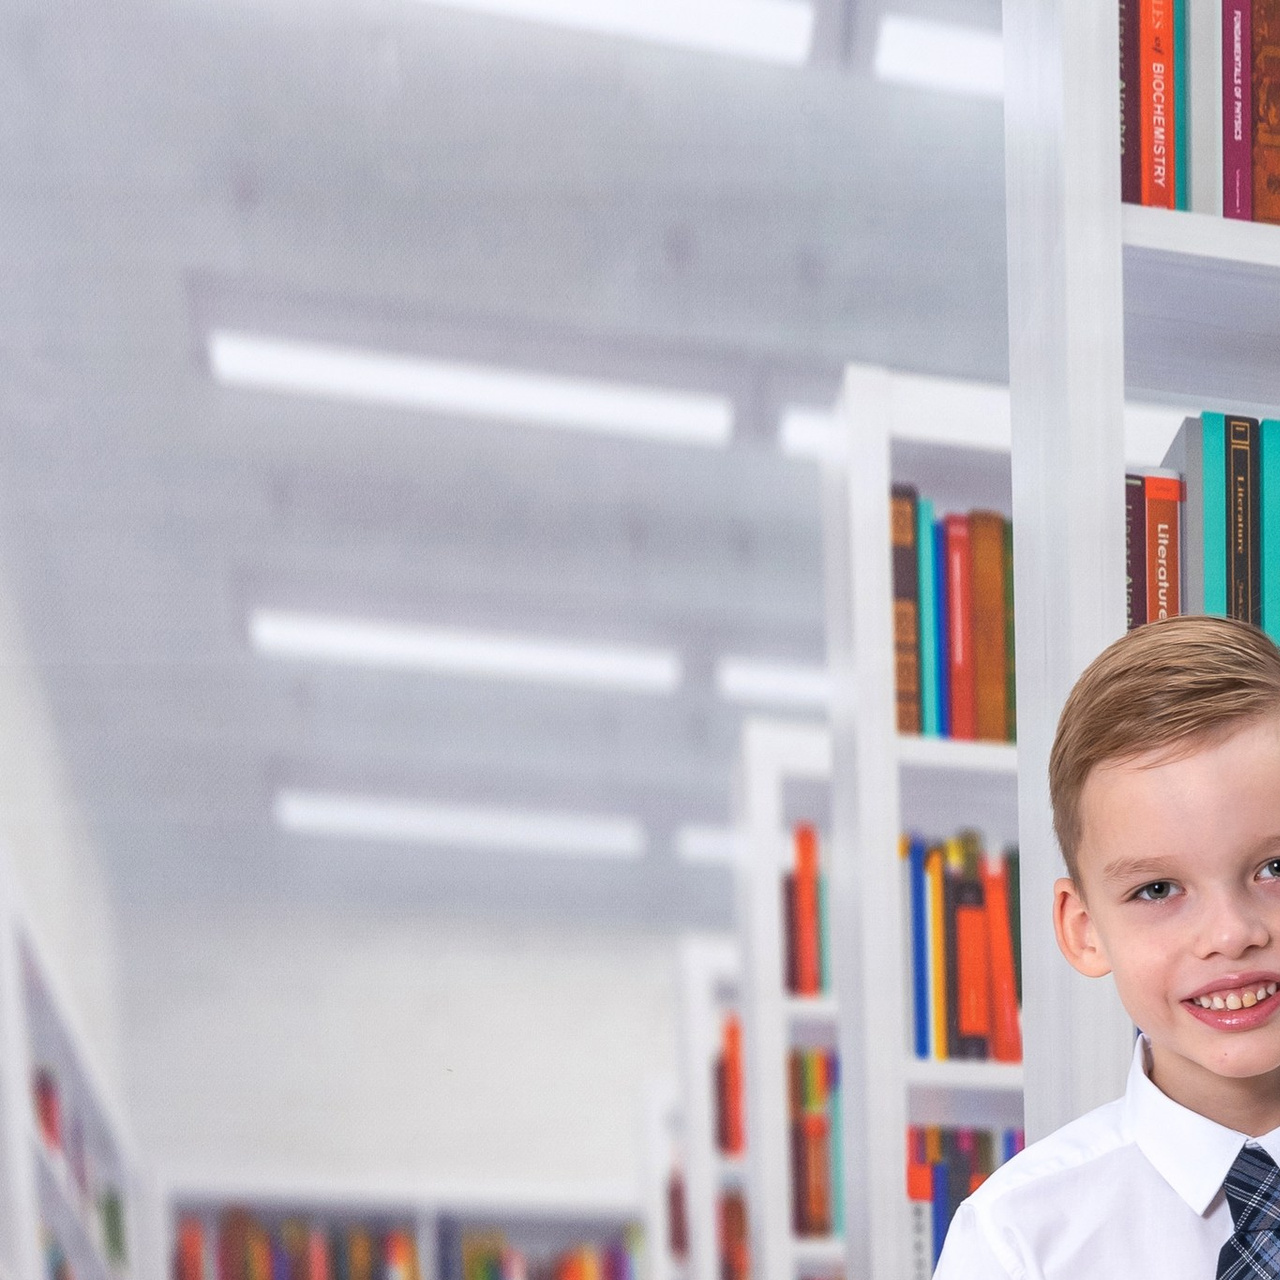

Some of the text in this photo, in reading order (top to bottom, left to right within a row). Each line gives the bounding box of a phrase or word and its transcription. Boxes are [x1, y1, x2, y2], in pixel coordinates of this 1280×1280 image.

[1152, 62, 1167, 188] BIOCHEMISTRY
[1232, 9, 1243, 141] FUNDAMENTALS OF PHYSICS
[1236, 476, 1245, 554] Literature
[1156, 523, 1170, 620] Literature
